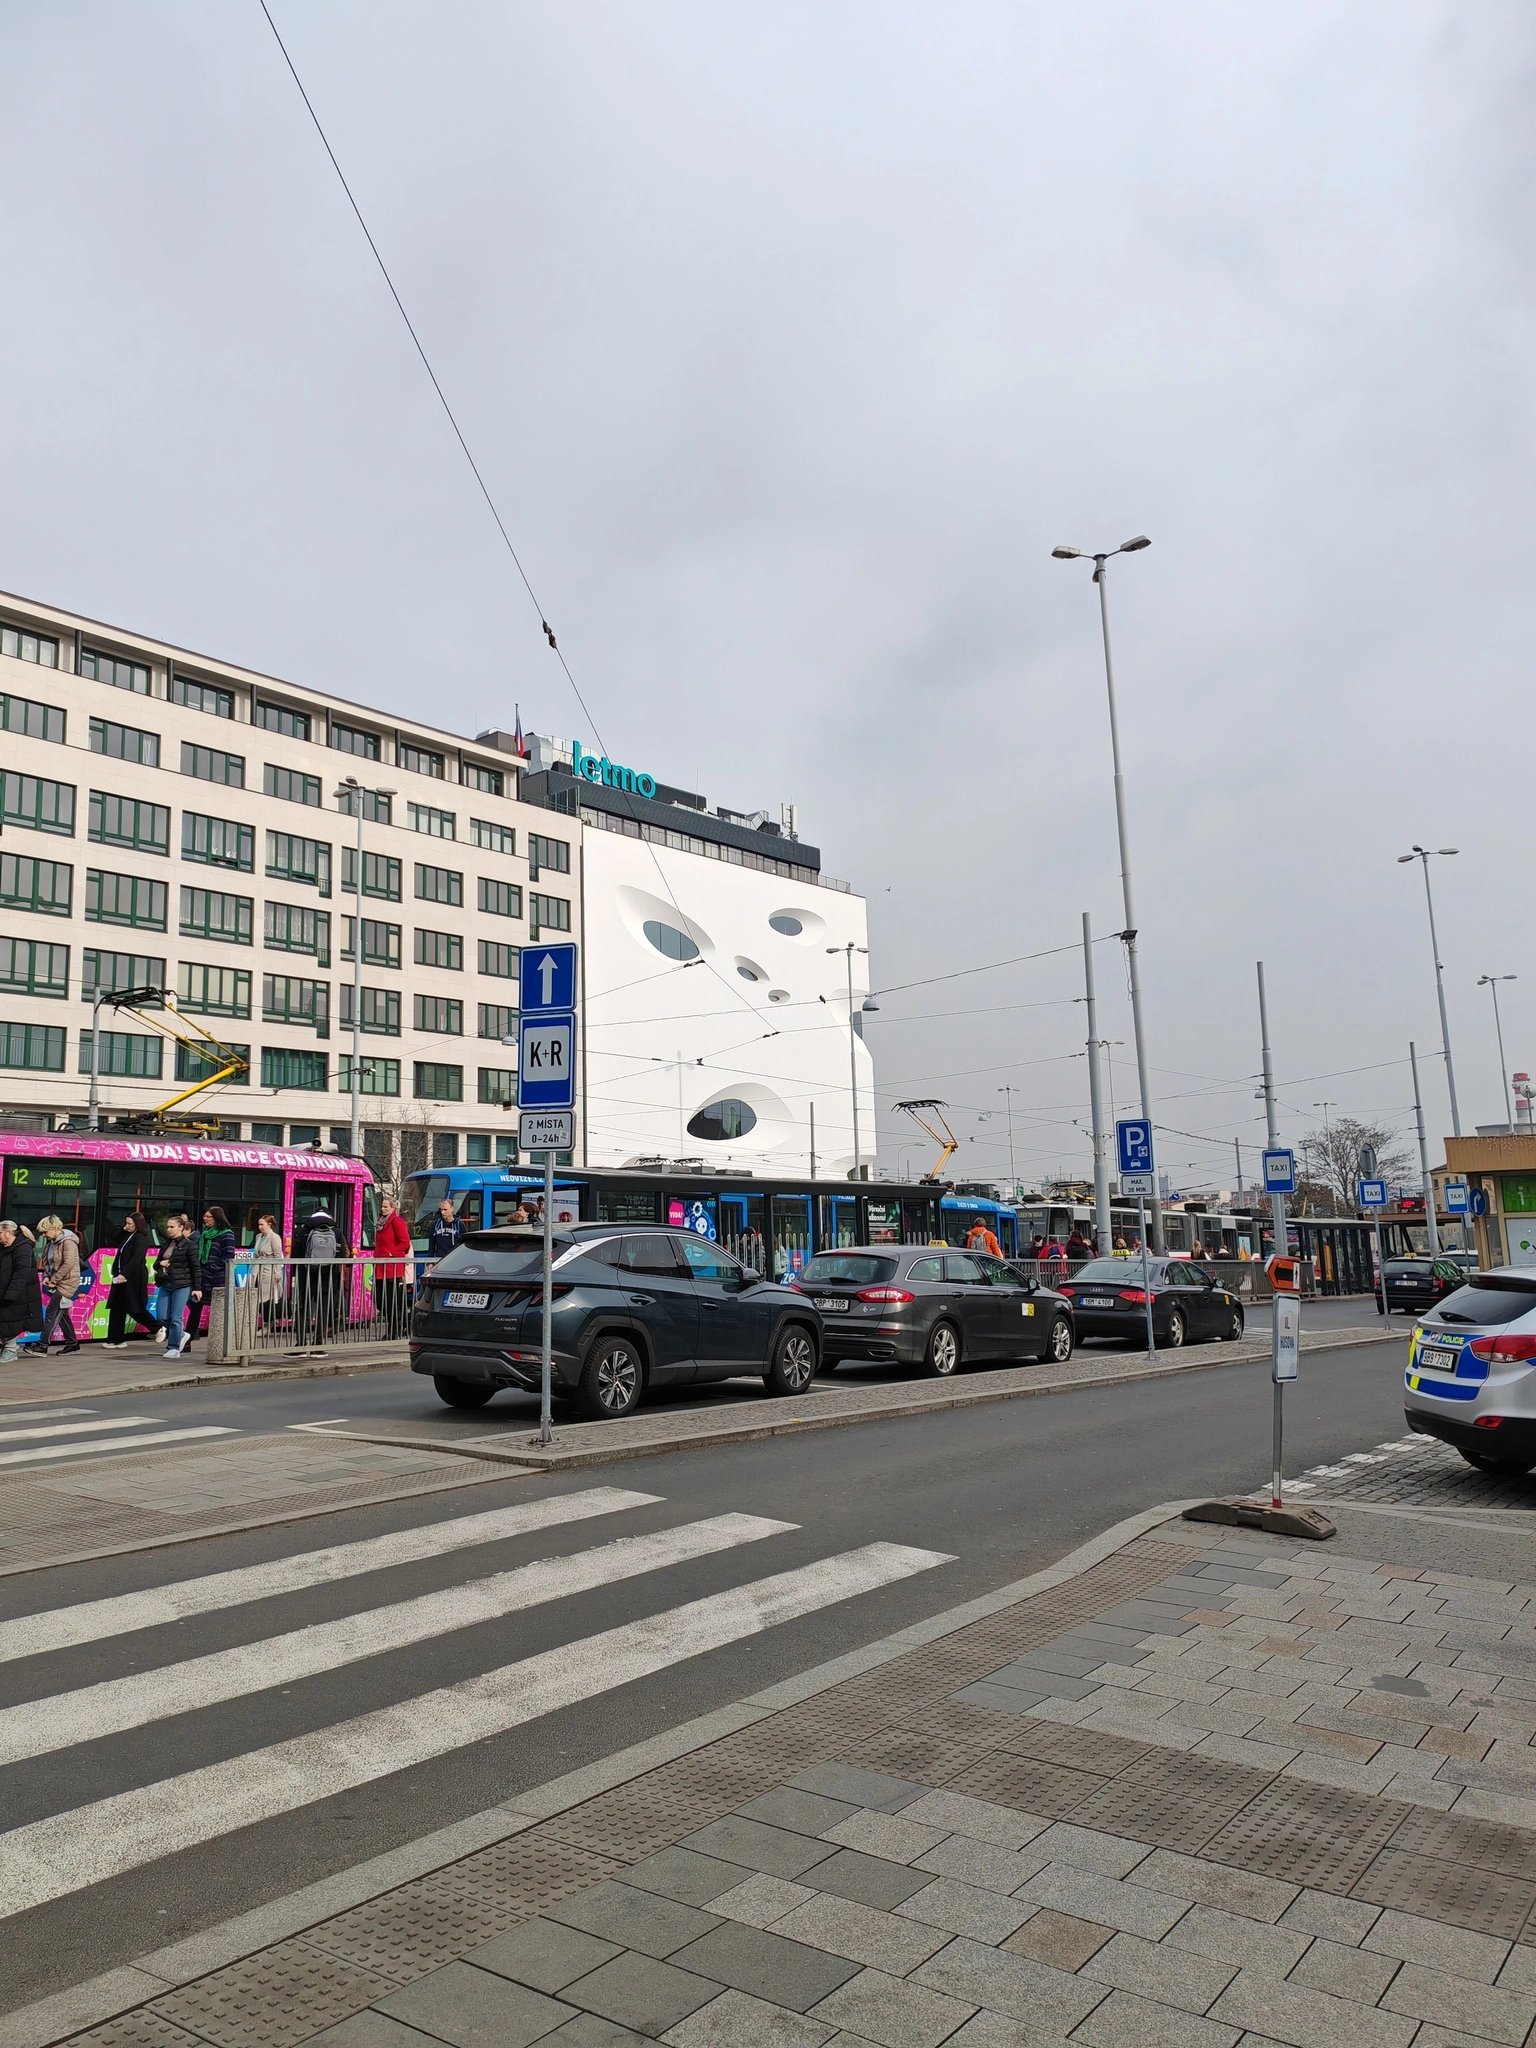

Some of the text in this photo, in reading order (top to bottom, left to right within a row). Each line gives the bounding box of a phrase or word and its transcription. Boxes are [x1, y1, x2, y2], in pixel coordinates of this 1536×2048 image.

[573, 740, 656, 800] letmo
[530, 1040, 562, 1068] K+R
[528, 1117, 564, 1129] 2 MÍSTA
[1125, 1126, 1145, 1157] P
[126, 1142, 349, 1170] VIDA! SCIENCE CENTRUM
[1269, 1163, 1288, 1172] TAXI
[12, 1168, 29, 1185] 12
[449, 1293, 486, 1305] 9AB 6546
[830, 1299, 846, 1309] 3105
[1441, 1334, 1465, 1345] POLICIE
